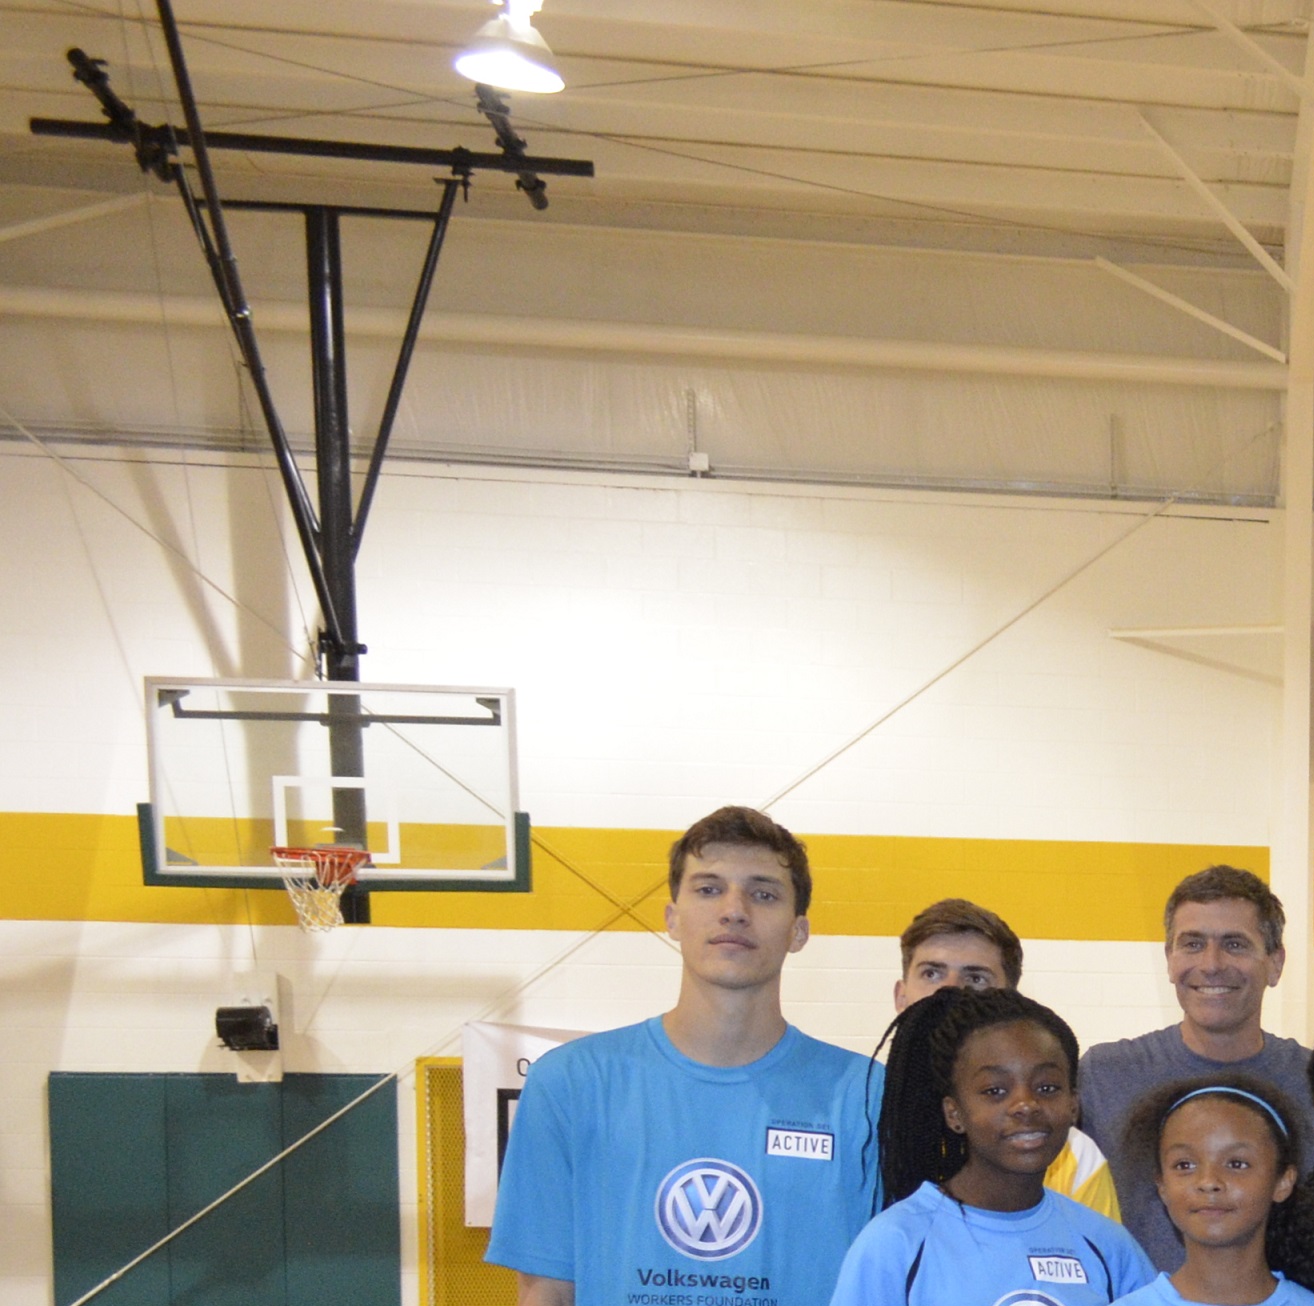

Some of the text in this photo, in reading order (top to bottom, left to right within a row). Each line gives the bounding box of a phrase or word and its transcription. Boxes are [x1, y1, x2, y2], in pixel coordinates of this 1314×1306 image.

[772, 1133, 830, 1155] ACTIVE
[1037, 1260, 1083, 1279] ACTIVE
[637, 1268, 770, 1293] Volkswagen
[628, 1293, 693, 1306] WORKERS
